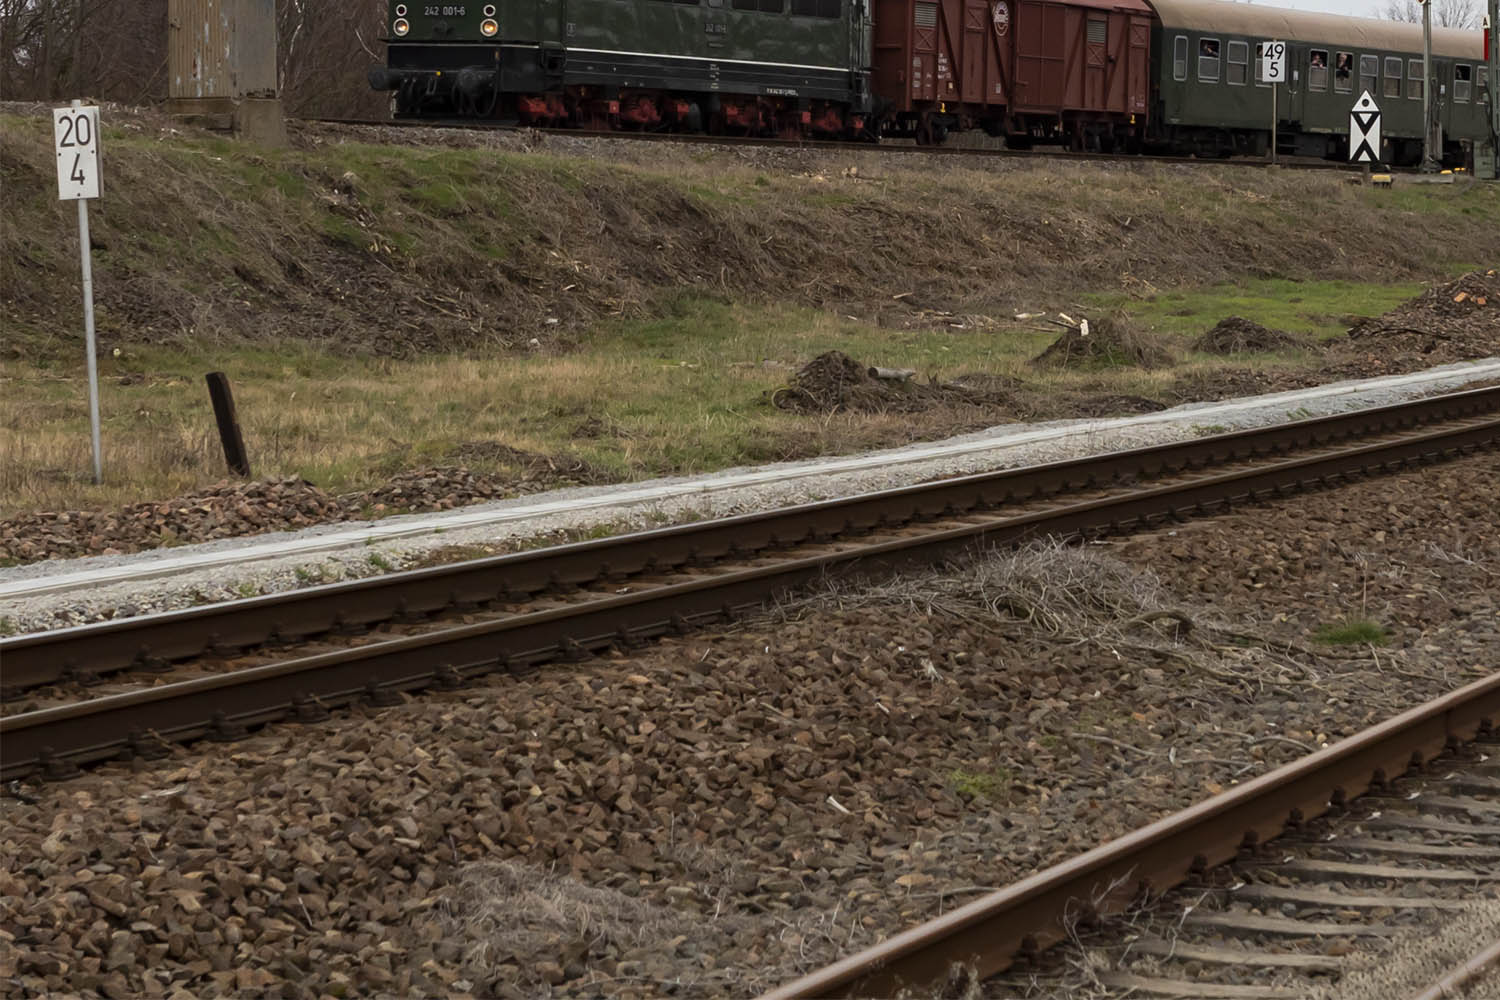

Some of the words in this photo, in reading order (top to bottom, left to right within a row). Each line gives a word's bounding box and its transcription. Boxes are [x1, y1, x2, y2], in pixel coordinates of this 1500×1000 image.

[424, 6, 440, 16] 242
[442, 6, 466, 16] 001-6
[1482, 16, 1489, 26] A
[1264, 43, 1285, 60] 49
[1268, 61, 1279, 78] 5
[58, 114, 91, 148] 20
[70, 152, 86, 186] 4
